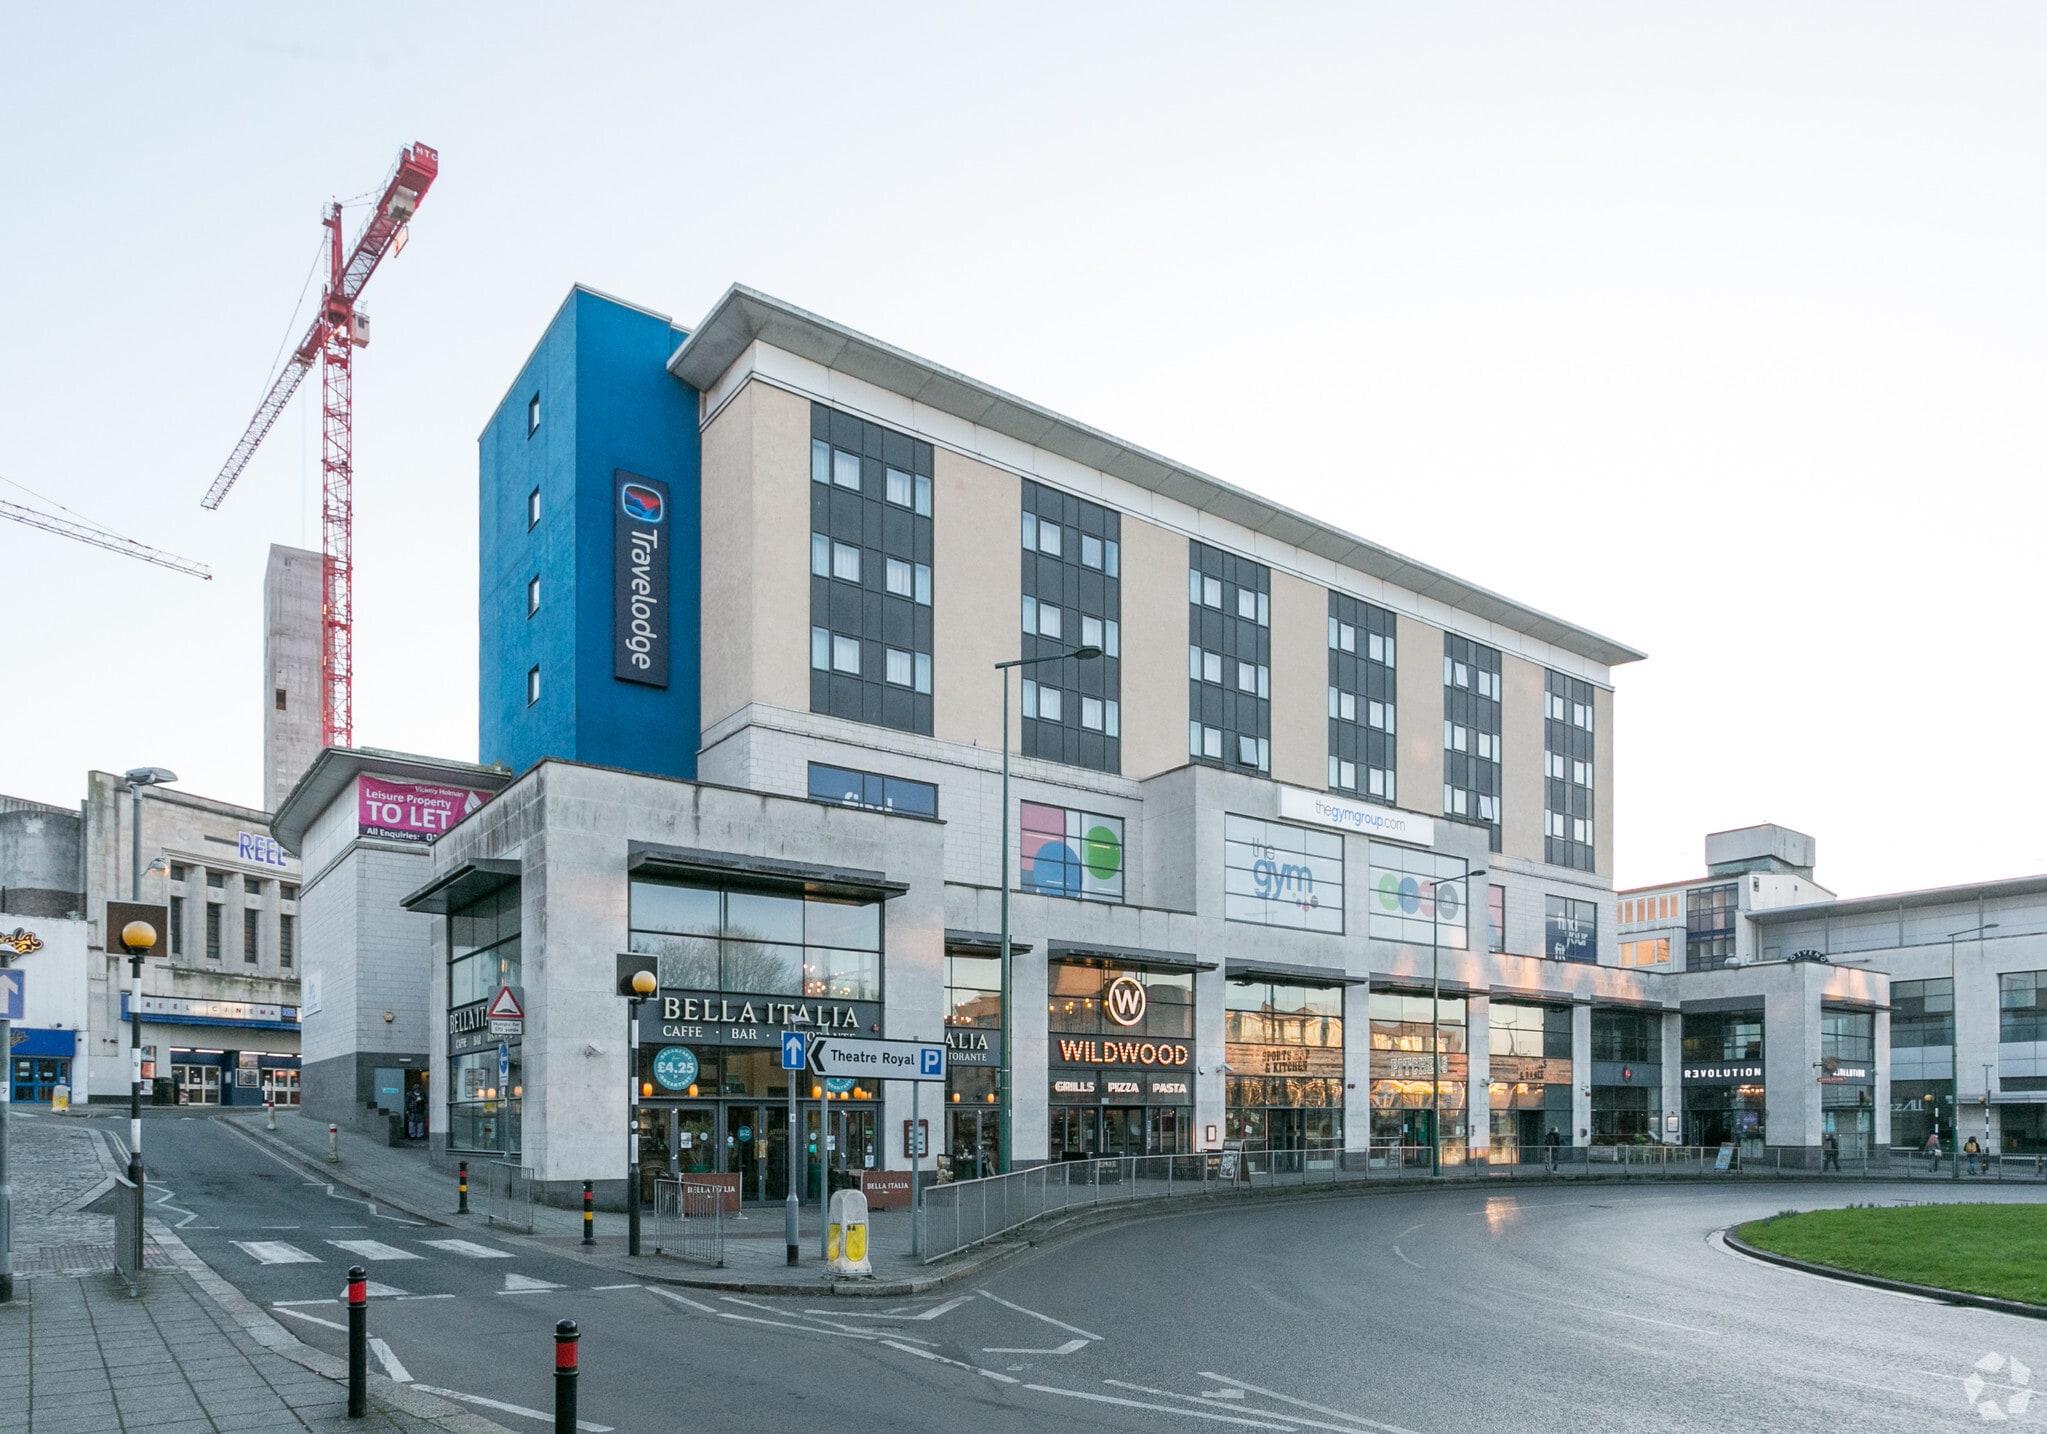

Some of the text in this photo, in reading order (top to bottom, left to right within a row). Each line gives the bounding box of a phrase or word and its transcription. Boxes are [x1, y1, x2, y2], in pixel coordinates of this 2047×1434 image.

[625, 529, 657, 670] Travelodge
[366, 789, 451, 809] Leisure Property
[439, 788, 464, 797] Holman
[366, 801, 451, 829] TO LET
[1316, 799, 1406, 832] thegymgroup.com
[366, 827, 378, 835] All
[380, 828, 420, 841] Enquiries:
[239, 831, 287, 867] REEL
[1253, 837, 1276, 870] the
[1253, 858, 1313, 901] gym
[1558, 911, 1578, 932] find
[1565, 930, 1588, 949] your
[1555, 942, 1566, 960] fit
[145, 1001, 190, 1011] REEL
[212, 1005, 276, 1016] CINEMA
[1114, 988, 1140, 1015] W
[449, 1009, 475, 1034] BELLA
[663, 996, 861, 1028] BELLA ITALIA
[662, 1025, 758, 1040] CAFFE BAR
[831, 1049, 939, 1073] Theatre Royal P
[1060, 1040, 1189, 1066] WILDWOOD
[1262, 1050, 1291, 1061] SPORTS
[657, 1061, 695, 1074] £4.25
[1273, 1061, 1308, 1073] KITCHEN
[1391, 1055, 1448, 1077] PITCHES
[1055, 1081, 1187, 1093] GRILLS PIZZA PASTA
[687, 1185, 736, 1194] BELLA ITLIA
[867, 1182, 887, 1190] BELLA
